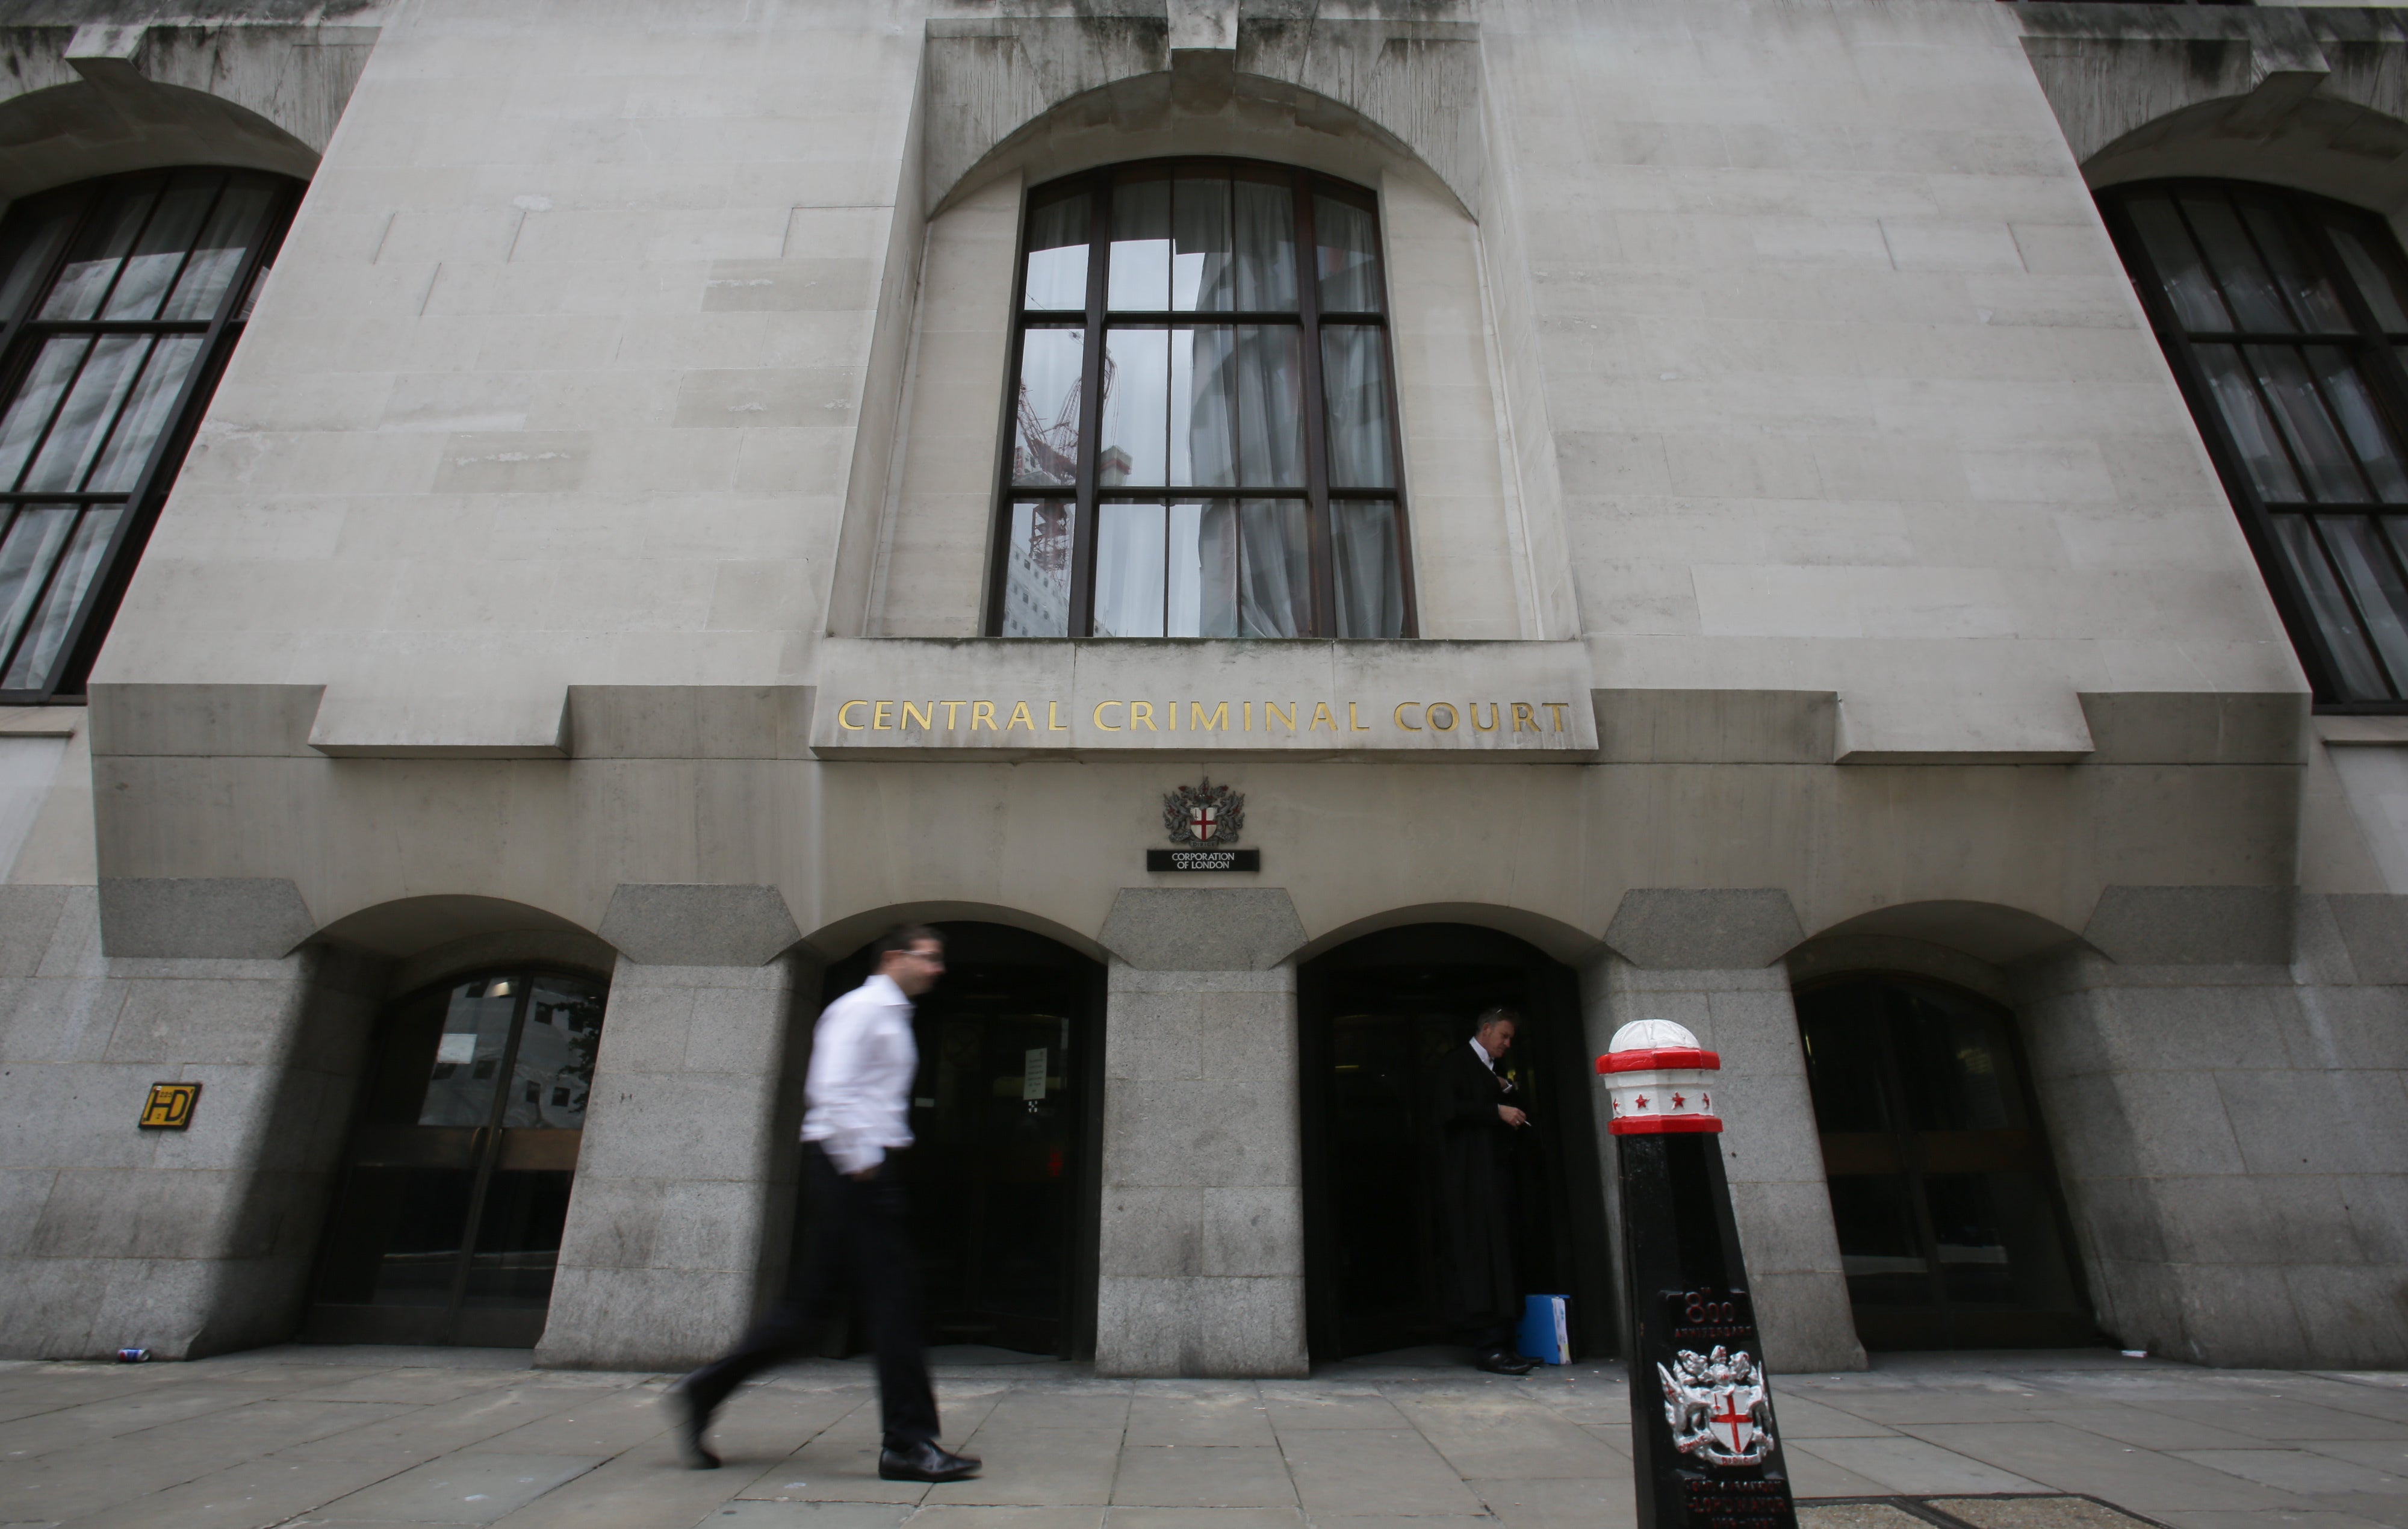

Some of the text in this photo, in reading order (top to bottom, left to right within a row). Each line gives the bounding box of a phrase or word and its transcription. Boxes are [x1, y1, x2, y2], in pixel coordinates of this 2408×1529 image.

[837, 700, 1569, 733] CENTRAL CRIMINAL COURT
[1685, 1291, 1735, 1324] 800
